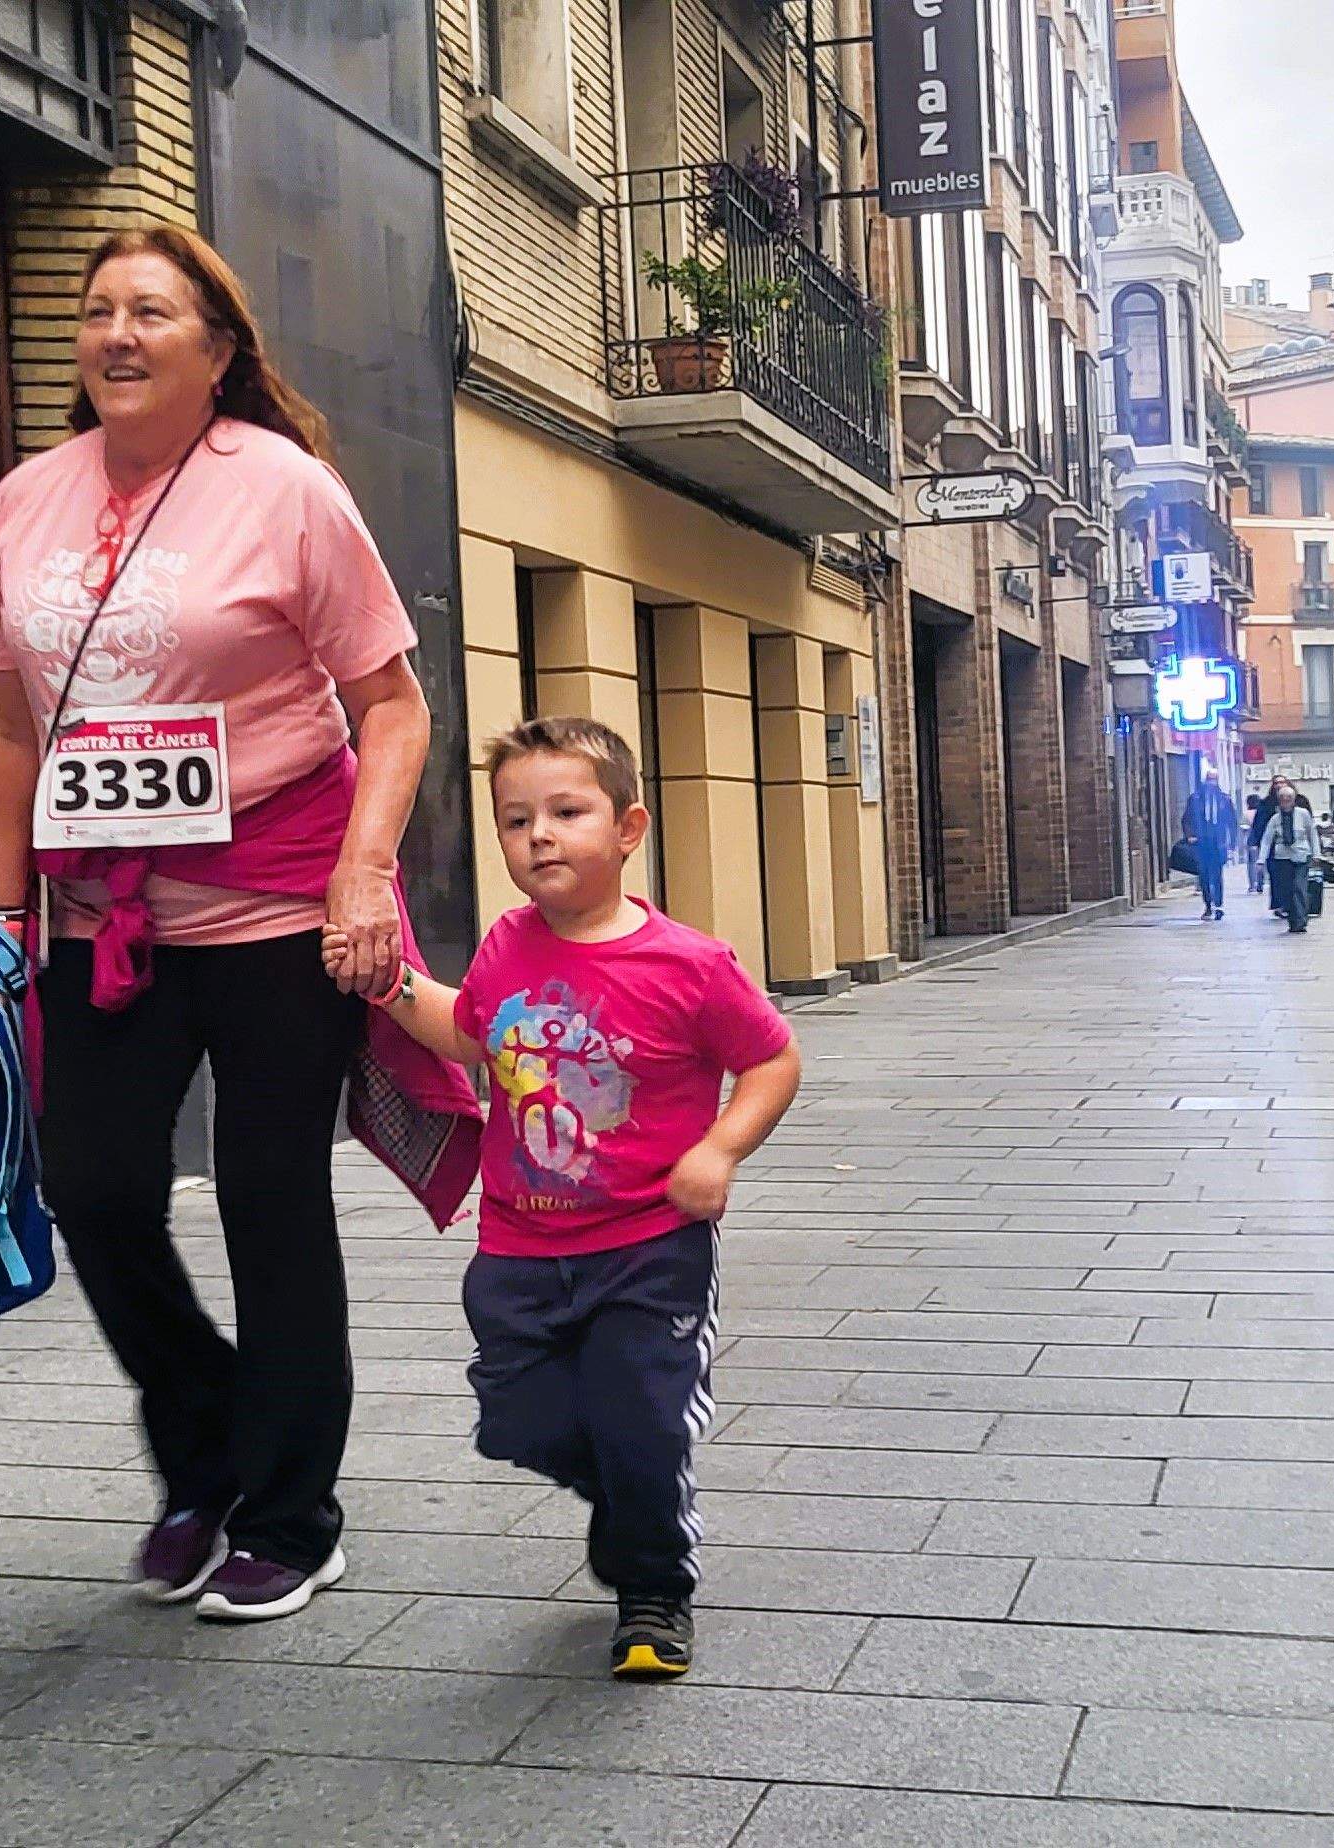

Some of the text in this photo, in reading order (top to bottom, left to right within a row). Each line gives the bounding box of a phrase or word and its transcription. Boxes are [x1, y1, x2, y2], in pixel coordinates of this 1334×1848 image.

[890, 170, 980, 196] muebles
[60, 730, 210, 751] CONTRA EL CÁNCER
[55, 756, 213, 811] 3330
